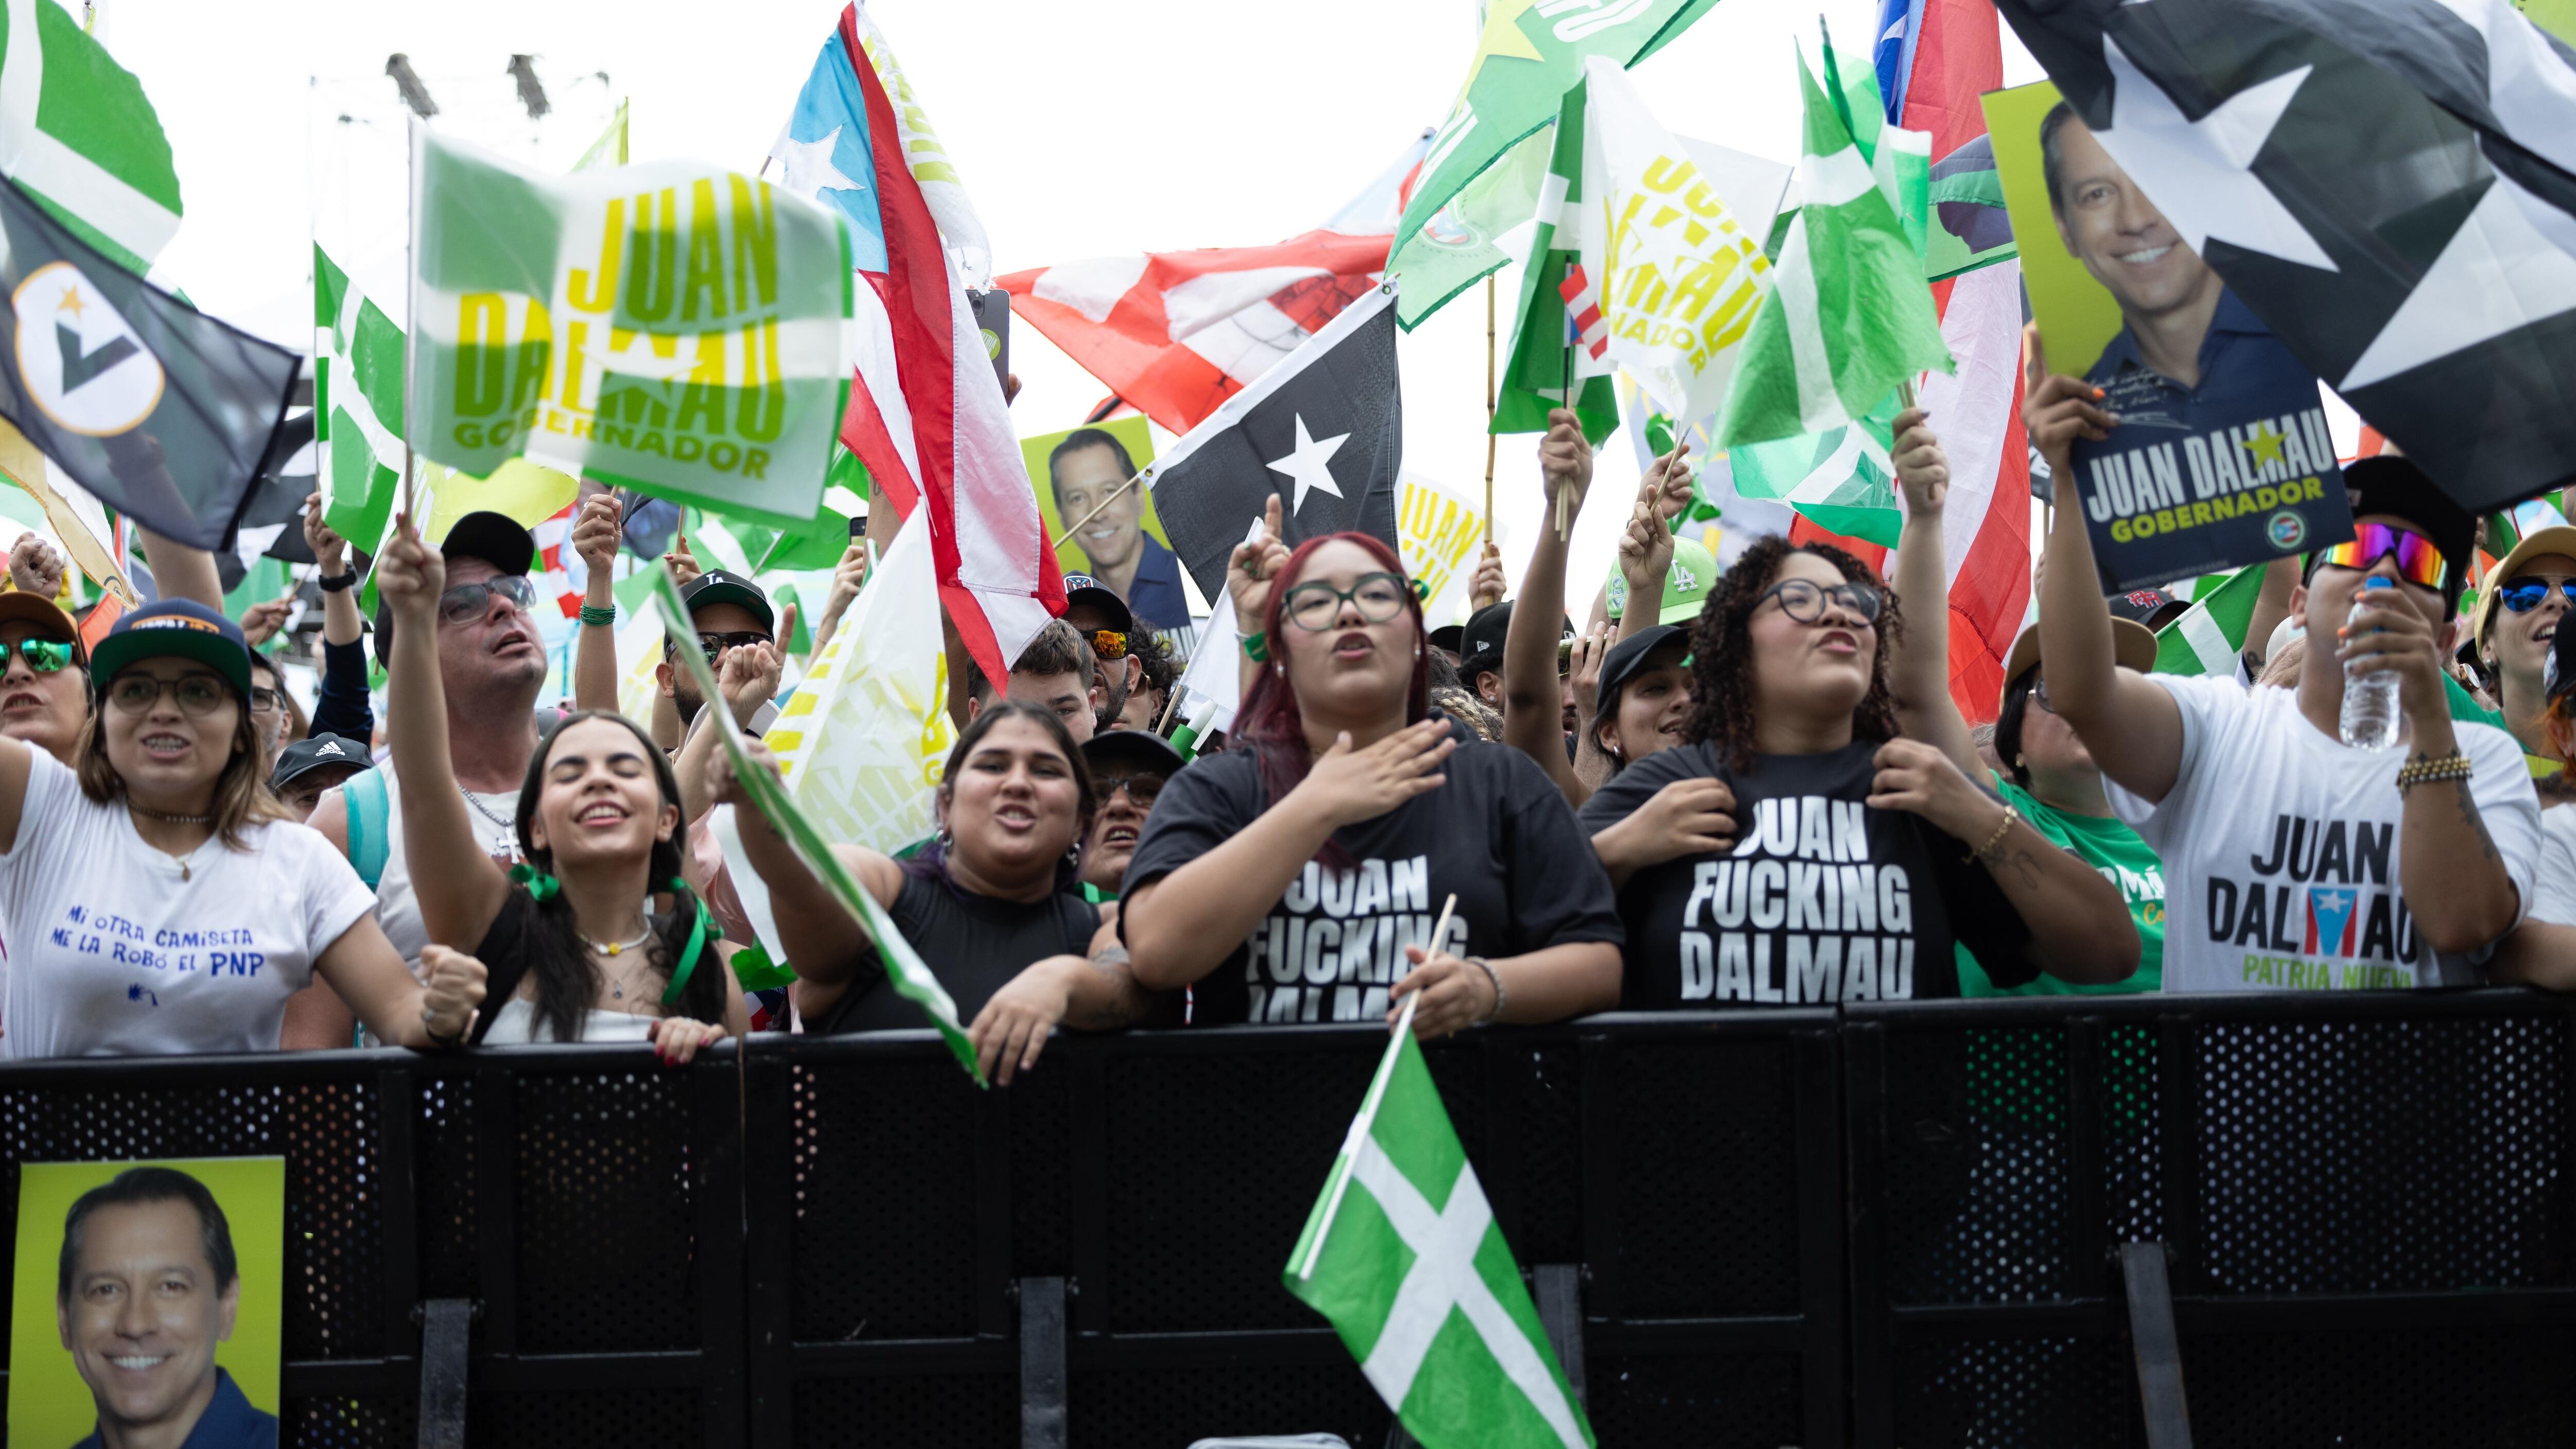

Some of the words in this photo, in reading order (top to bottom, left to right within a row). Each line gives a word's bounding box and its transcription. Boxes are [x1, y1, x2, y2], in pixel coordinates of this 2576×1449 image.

[567, 173, 779, 323] JUAN
[455, 292, 786, 443] DALMAU
[453, 406, 771, 480] GOBERNADOR
[2087, 441, 2186, 522] JUAN
[2183, 408, 2334, 500] DALMAU
[2111, 476, 2325, 543] GOBERNADOR
[1671, 559, 1698, 592] LA
[315, 748, 346, 757] adidas
[1732, 795, 1868, 862] JUAN
[2250, 814, 2394, 884] JUAN
[1284, 855, 1429, 917] JUAN
[1684, 860, 1913, 933] FUCKING
[2207, 876, 2418, 965] DALMAU
[50, 927, 73, 947] ME
[78, 934, 100, 954] LA
[179, 954, 196, 971] EL
[209, 952, 265, 977] PNP
[1246, 915, 1469, 983] FUCKING
[1680, 931, 1916, 1003] DALMAU
[2243, 954, 2331, 988] PATRIA
